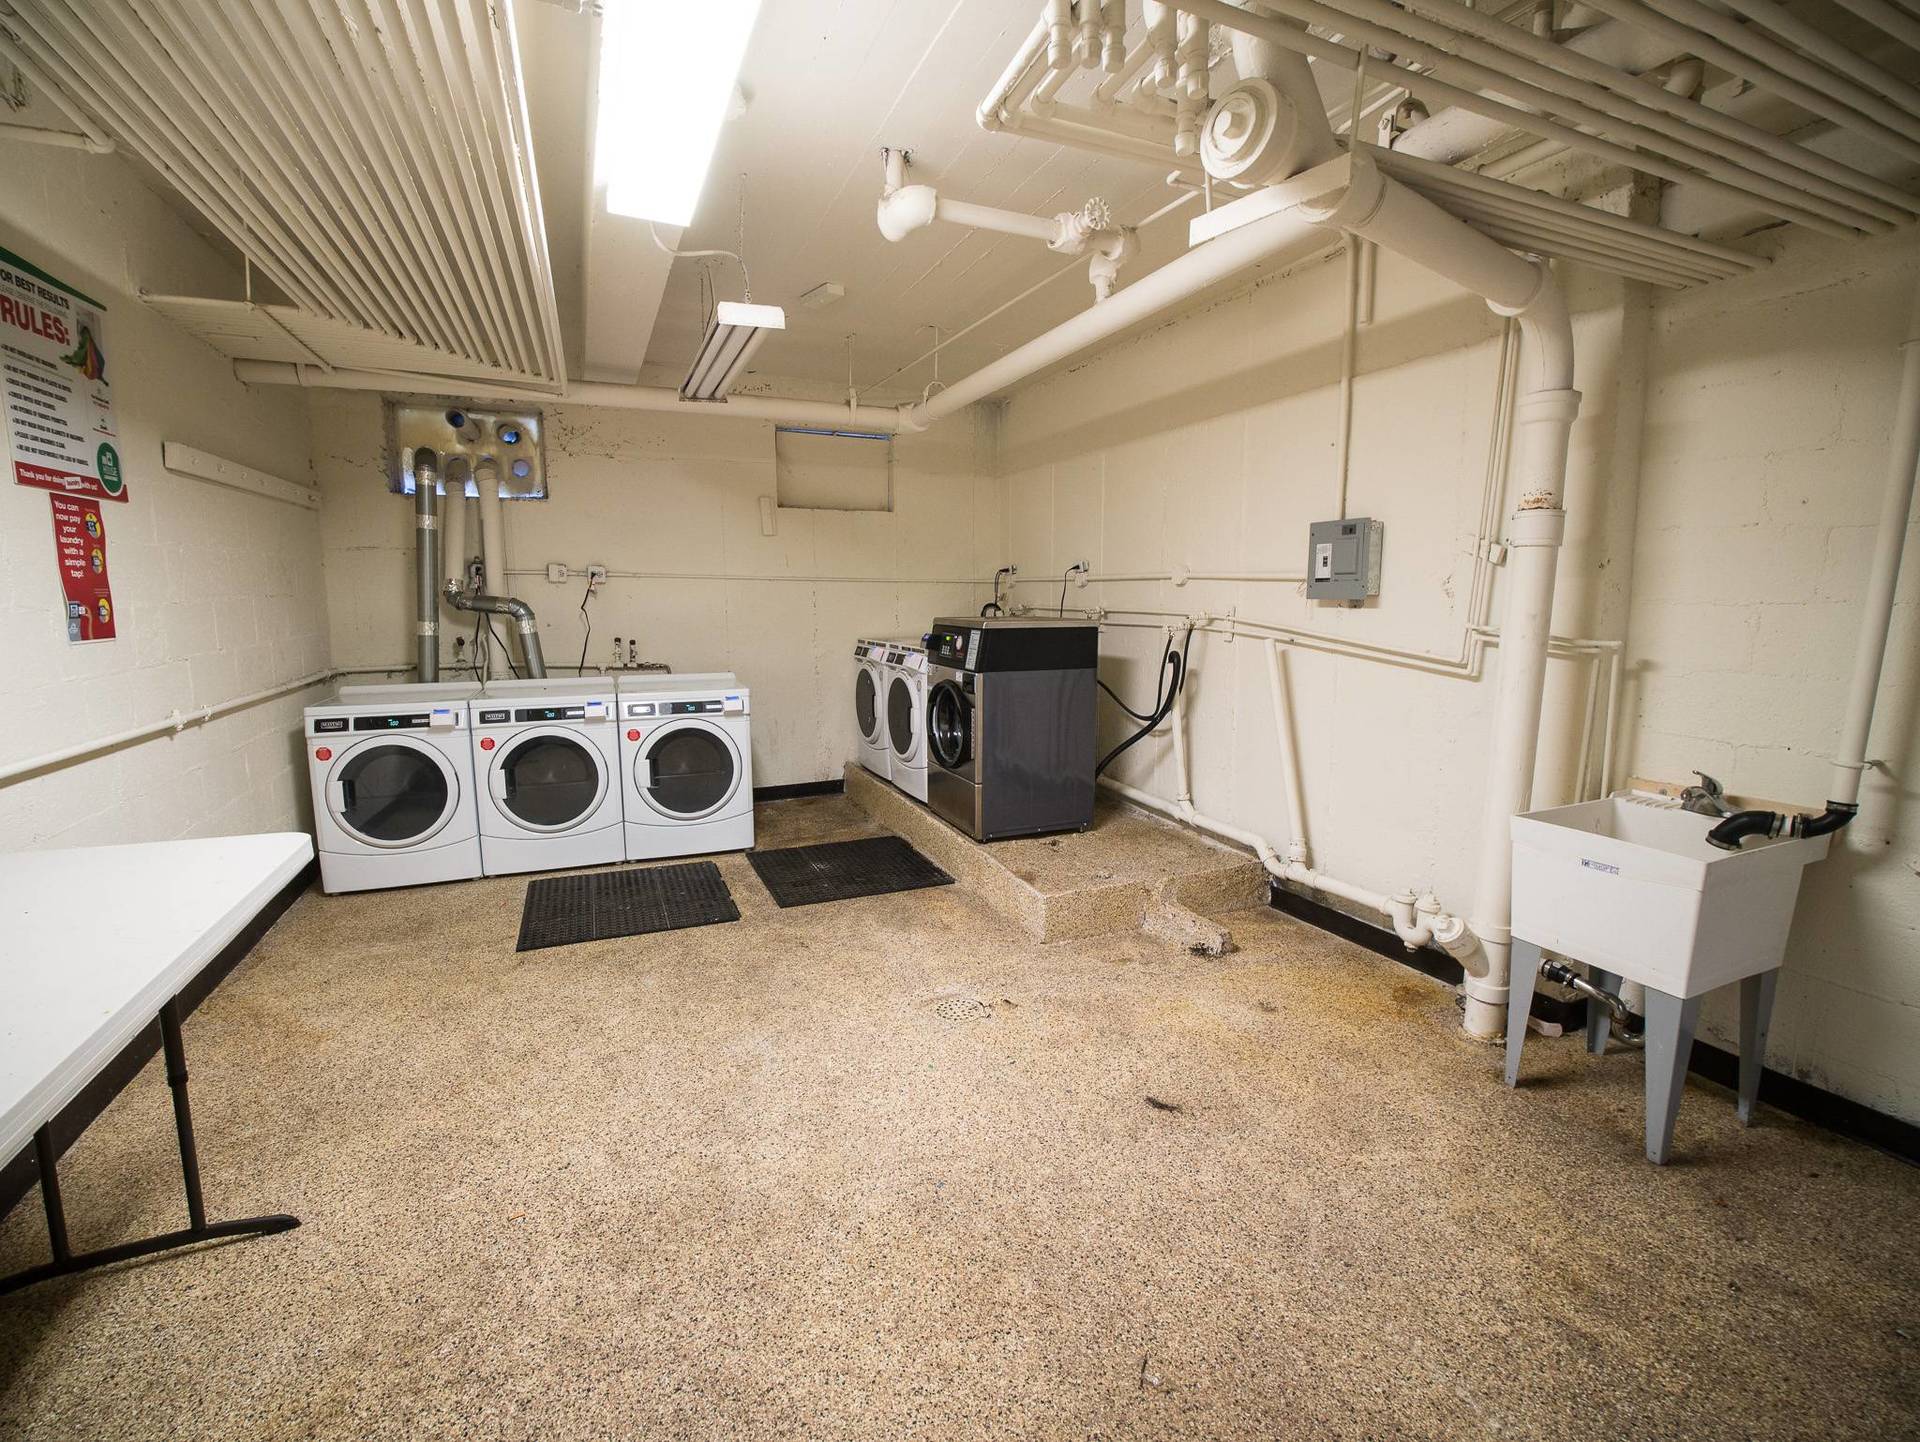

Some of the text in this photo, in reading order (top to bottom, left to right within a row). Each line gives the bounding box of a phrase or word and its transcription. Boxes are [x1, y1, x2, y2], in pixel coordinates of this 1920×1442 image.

[0, 268, 13, 284] OR
[15, 276, 35, 294] BEST
[37, 286, 70, 310] RESULTS
[0, 294, 71, 346] RULES:
[19, 468, 35, 479] Thank
[35, 473, 45, 481] you
[54, 501, 66, 511] You
[67, 503, 79, 512] can
[55, 513, 81, 524] now pay
[62, 525, 77, 534] your
[59, 535, 84, 546] laundry
[64, 558, 86, 568] simple
